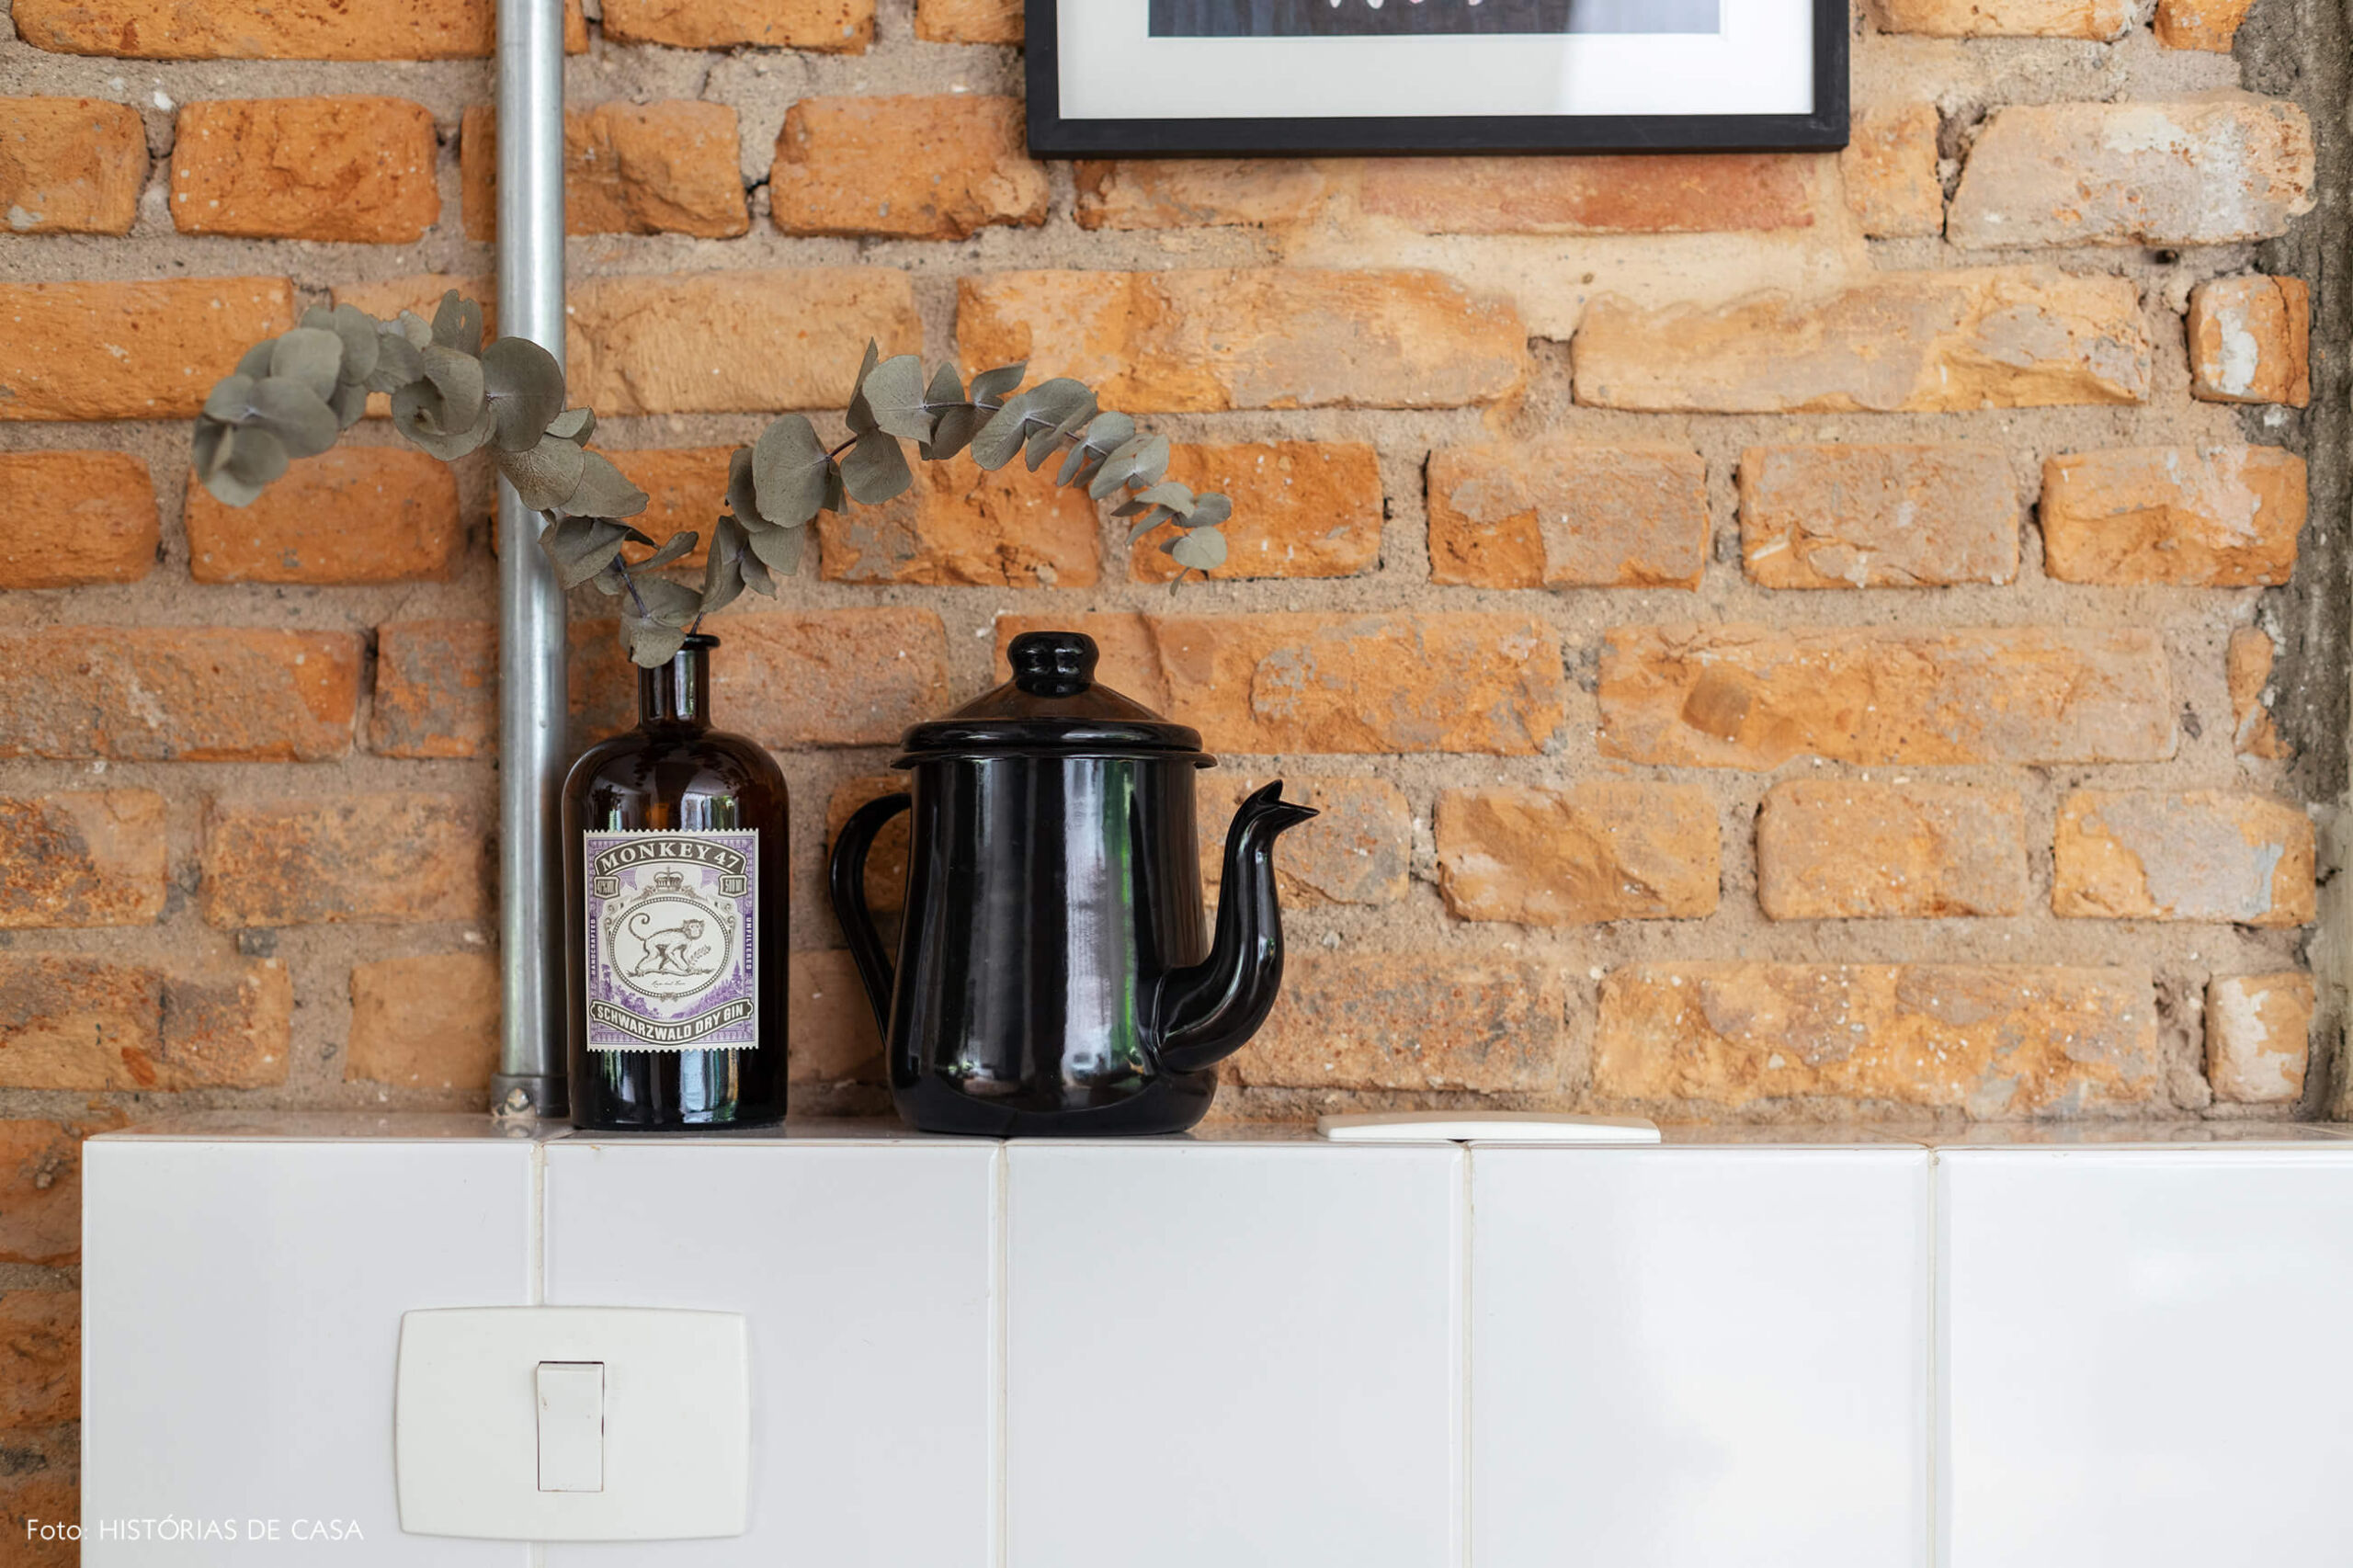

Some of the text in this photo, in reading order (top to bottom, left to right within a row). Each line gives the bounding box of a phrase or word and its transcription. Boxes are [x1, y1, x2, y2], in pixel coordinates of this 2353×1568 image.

[599, 841, 741, 872] MONKEY 47
[597, 1006, 745, 1041] SCHWARZWALD DRY GIN
